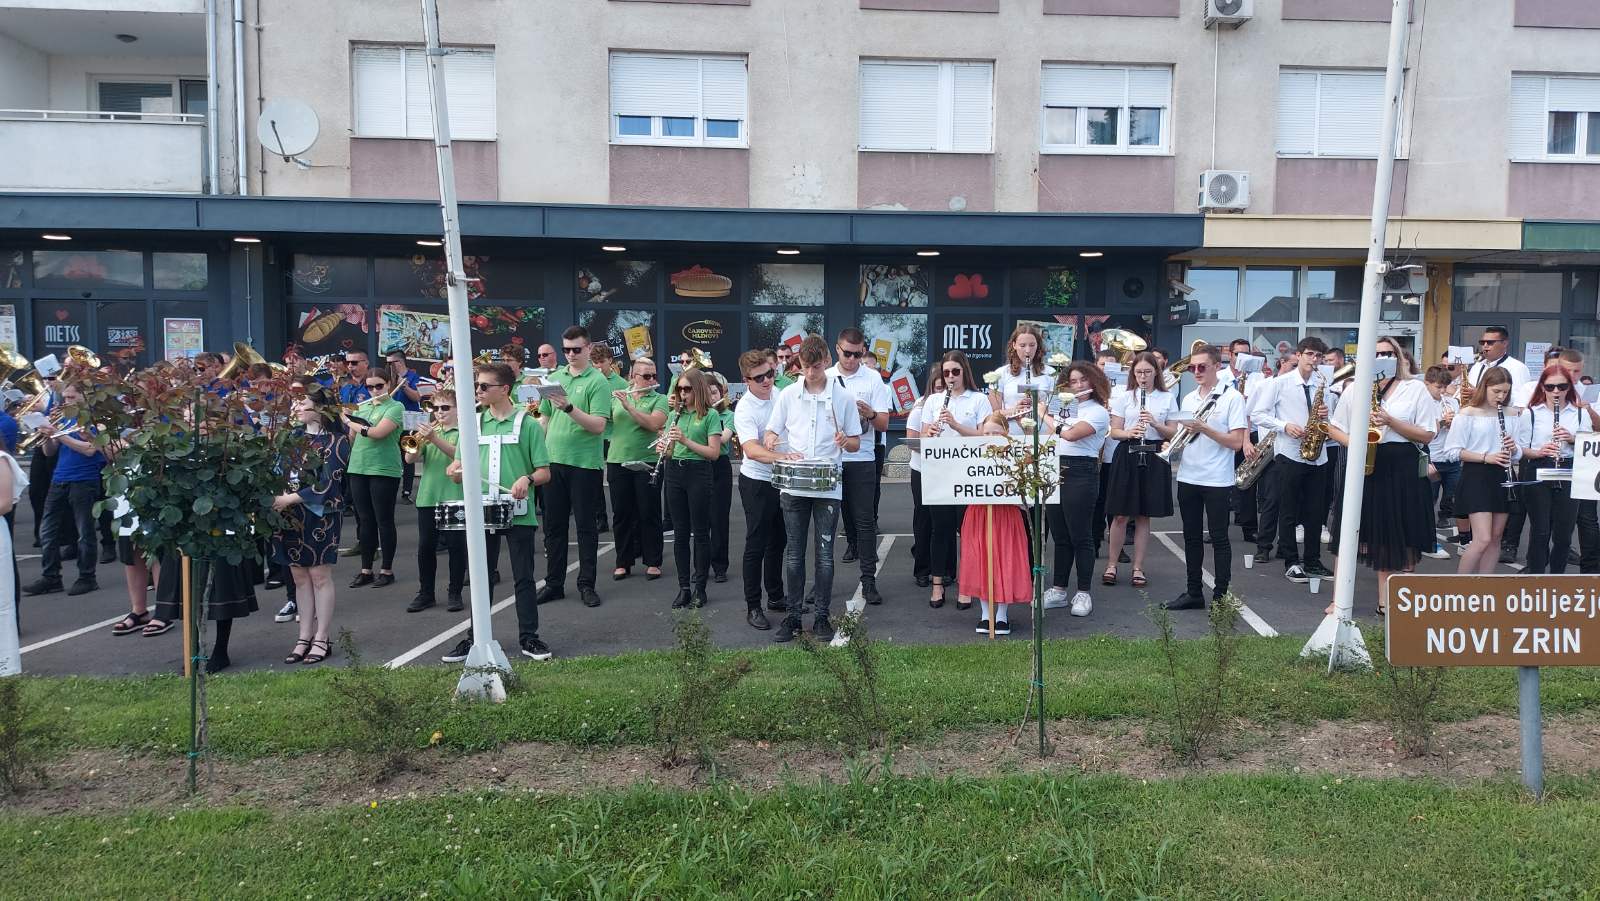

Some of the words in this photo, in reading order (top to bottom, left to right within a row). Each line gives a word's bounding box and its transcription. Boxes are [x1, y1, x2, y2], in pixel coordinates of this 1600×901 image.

[45, 325, 80, 342] METSS
[943, 324, 992, 349] METSS
[925, 444, 981, 459] PUHAČKI
[954, 483, 1020, 498] PRELOG
[1397, 587, 1496, 618] Spomen
[1506, 588, 1600, 619] obilježj
[1427, 627, 1499, 654] NOVI
[1512, 627, 1581, 654] ZRIN
